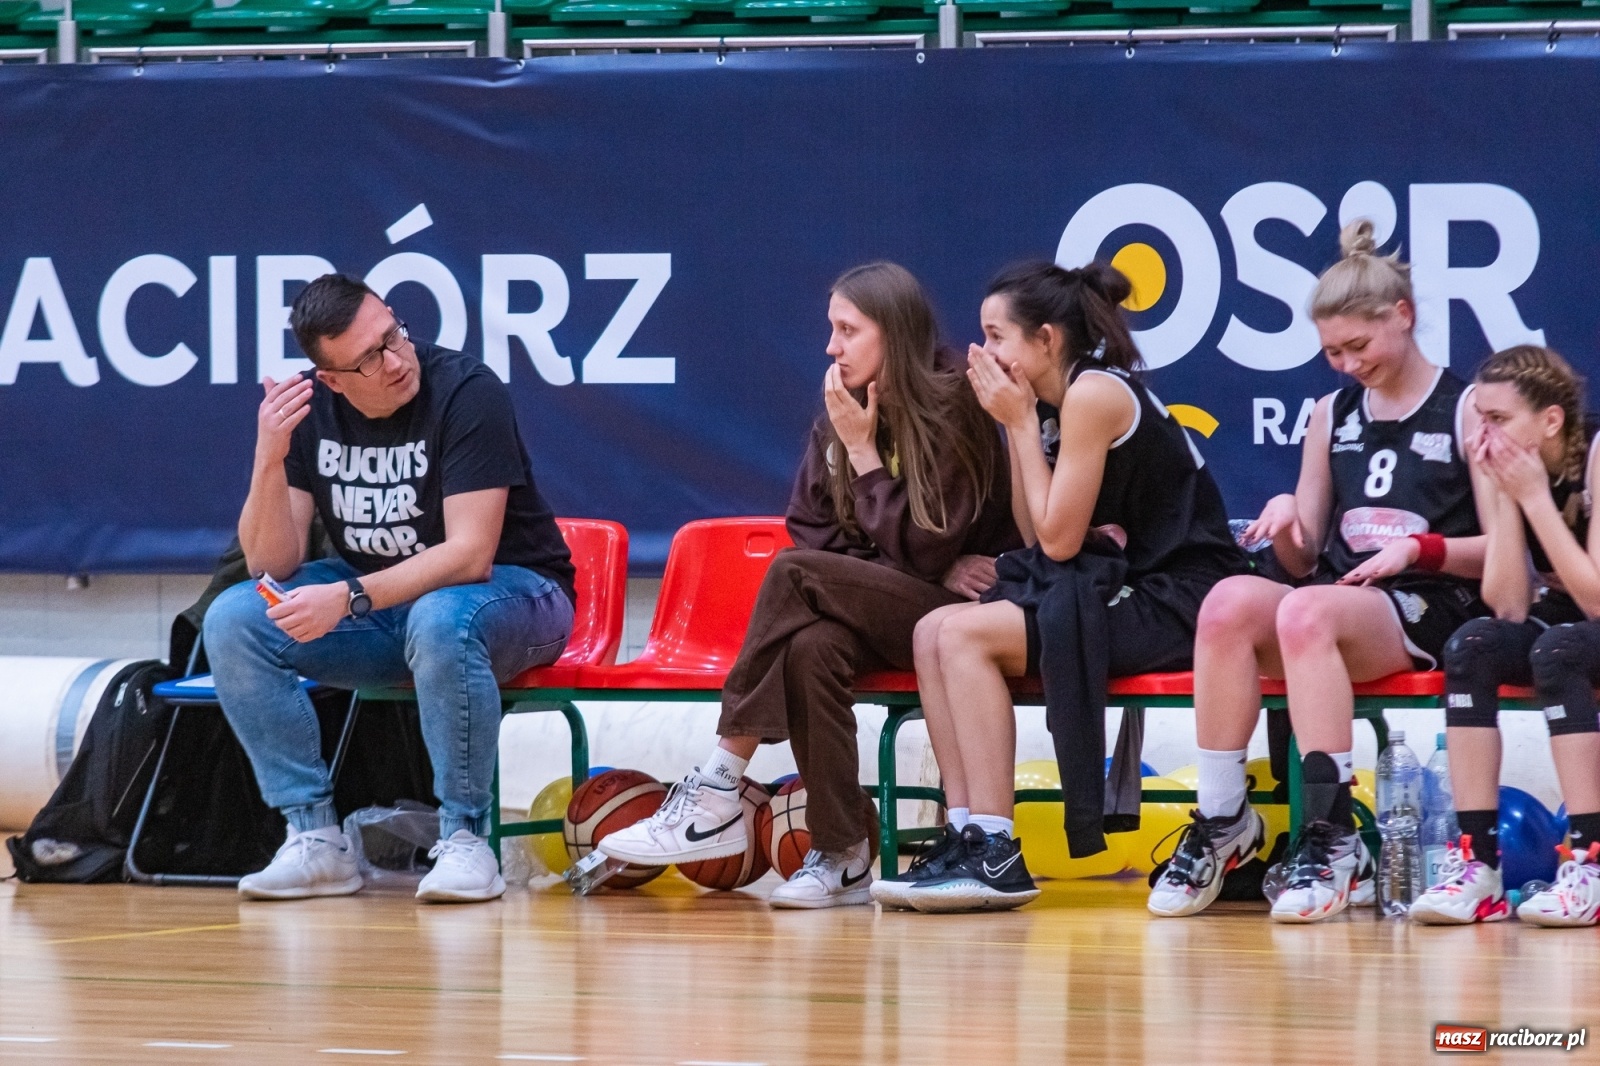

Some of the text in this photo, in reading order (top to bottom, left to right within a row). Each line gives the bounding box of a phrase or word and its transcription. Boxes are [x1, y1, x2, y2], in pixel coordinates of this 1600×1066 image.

[318, 439, 428, 483] BUCKTS
[1364, 448, 1398, 498] 8
[331, 484, 424, 524] NEVER
[344, 525, 427, 557] STOP.
